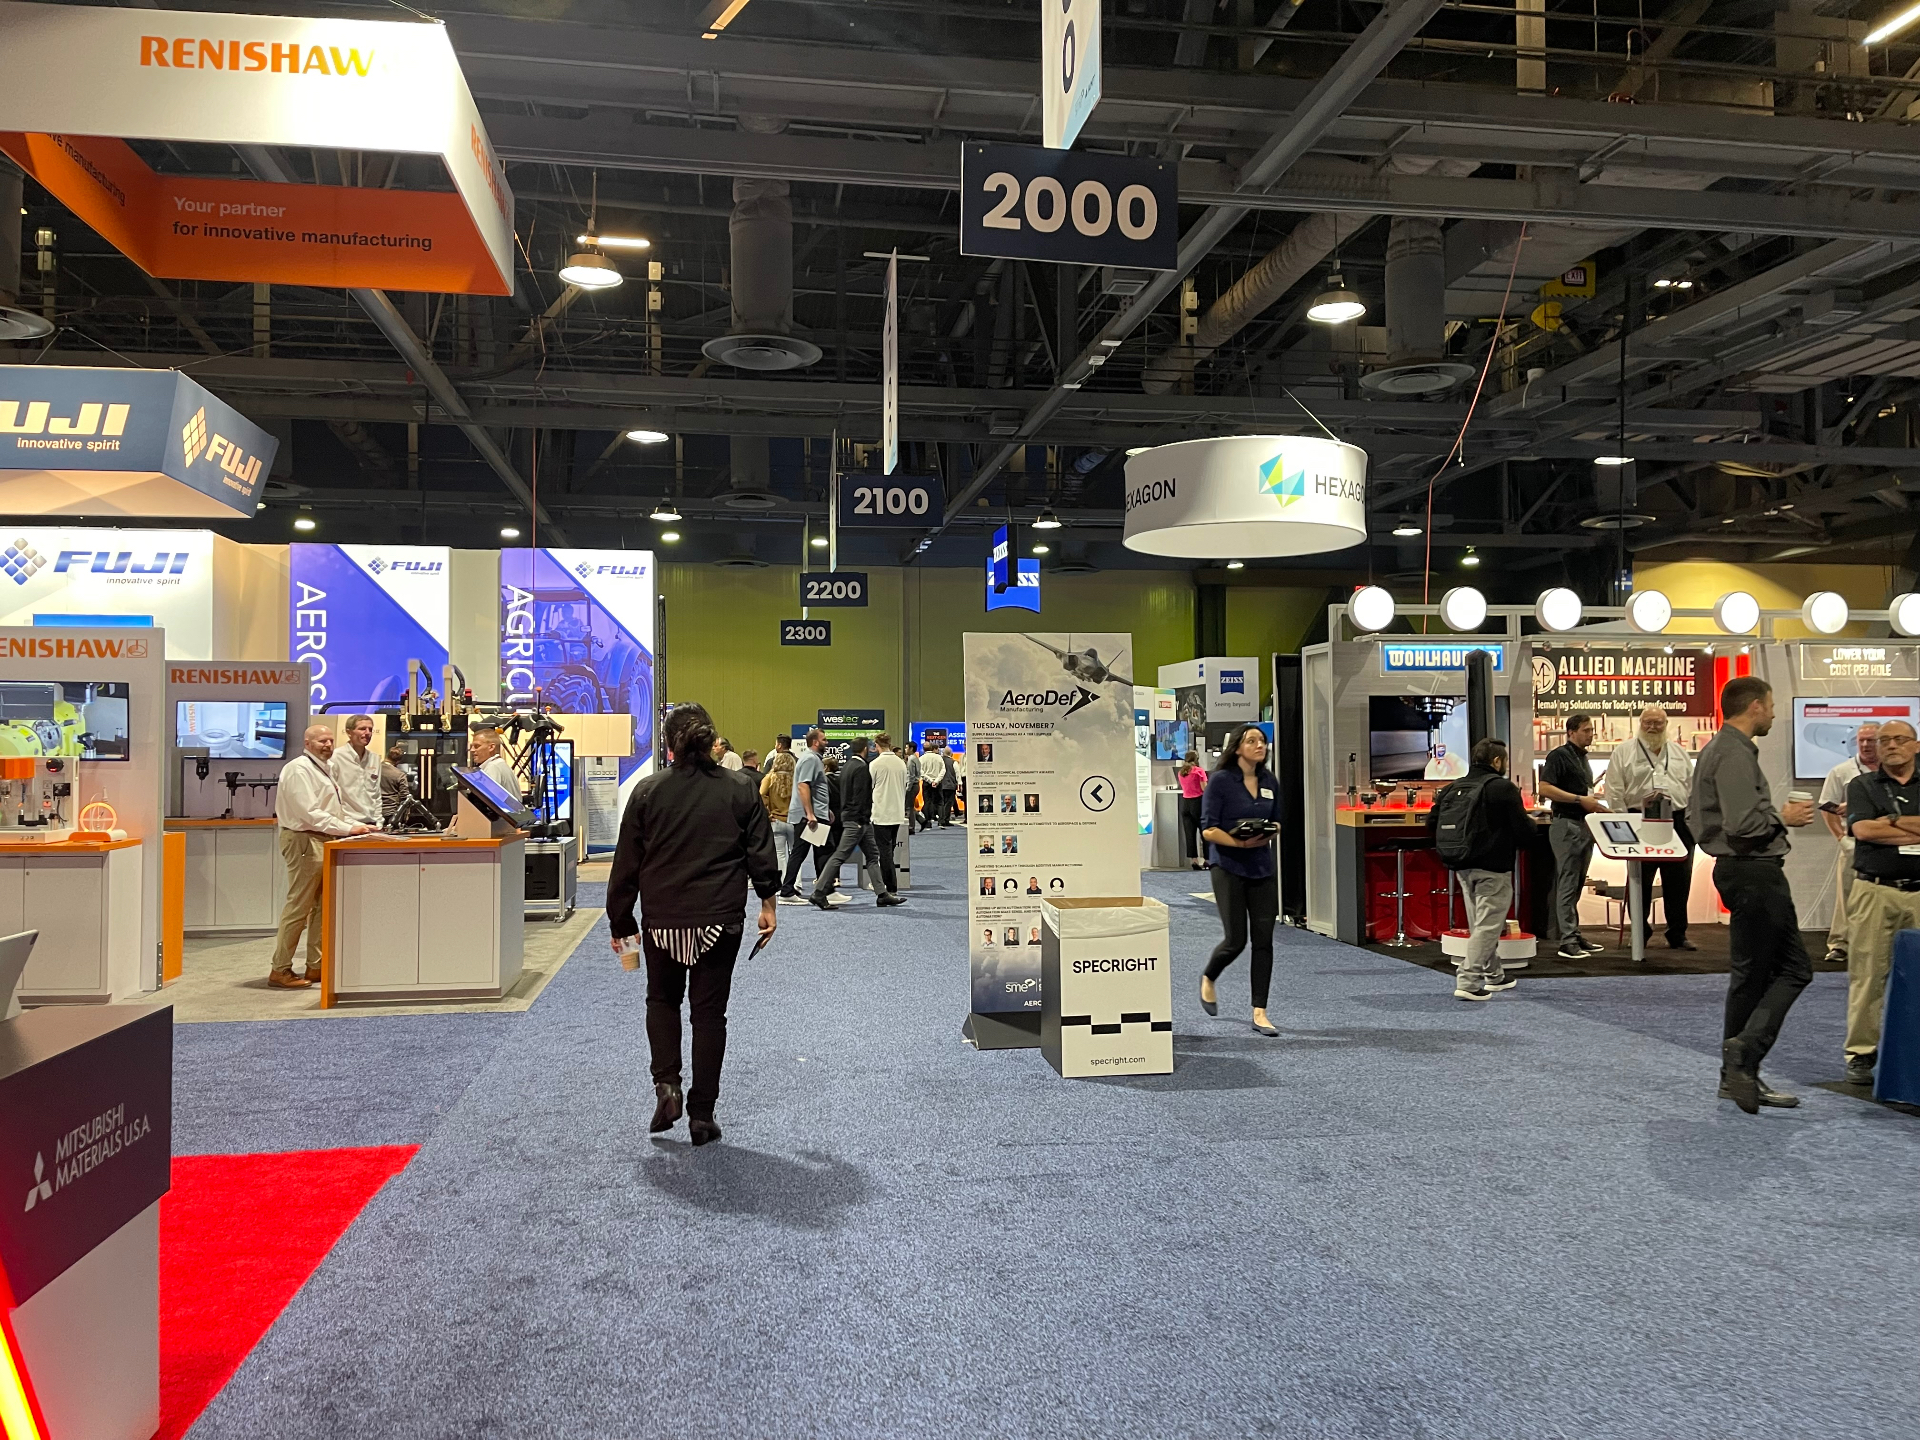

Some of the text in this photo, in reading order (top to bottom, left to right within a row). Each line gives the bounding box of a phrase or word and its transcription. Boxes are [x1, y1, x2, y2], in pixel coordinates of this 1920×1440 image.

[140, 36, 375, 77] RENISHAW
[65, 141, 125, 207] manufacturing
[173, 197, 286, 222] Your partner
[982, 171, 1159, 241] 2000
[172, 221, 432, 252] for innovative manufacturing
[0, 401, 130, 436] UJI
[17, 438, 120, 452] innovative spirit
[205, 433, 262, 485] FUJI
[1126, 478, 1176, 513] EXAGON
[1315, 474, 1365, 504] HEXAGO
[853, 487, 929, 515] 2100
[54, 551, 189, 575] FUJI
[390, 561, 443, 572] FUJI
[596, 565, 647, 575] FUJI
[157, 577, 181, 585] spirit
[988, 571, 1040, 587] ZSS
[806, 581, 861, 600] 2200
[785, 626, 826, 640] 2300
[0, 638, 123, 658] ENISHAW
[296, 581, 327, 714] AEROS
[506, 584, 534, 713] AGRICU
[1833, 648, 1885, 661] LOWER YOUR
[1389, 650, 1498, 667] WOHLHAUR
[1559, 656, 1695, 676] ALLIED MACHINE
[171, 669, 283, 685] RENISHAW
[1830, 664, 1892, 676] COST PER HOLE
[1558, 680, 1695, 695] & ENGINEERING
[1000, 690, 1077, 706] AeroDef
[1570, 700, 1601, 710] Solutions
[1602, 700, 1612, 710] for
[1612, 700, 1637, 712] Today's
[1638, 700, 1687, 713] Manufacturing
[823, 715, 858, 723] westec
[972, 722, 1008, 730] TUESDAY,
[1644, 846, 1674, 855] Pro
[1072, 957, 1157, 974] SPECRIGHT
[1005, 984, 1028, 992] sme
[1090, 1055, 1146, 1066] specright.com
[55, 1102, 124, 1164] MITSUBISHI
[55, 1132, 122, 1192] MATERIALS
